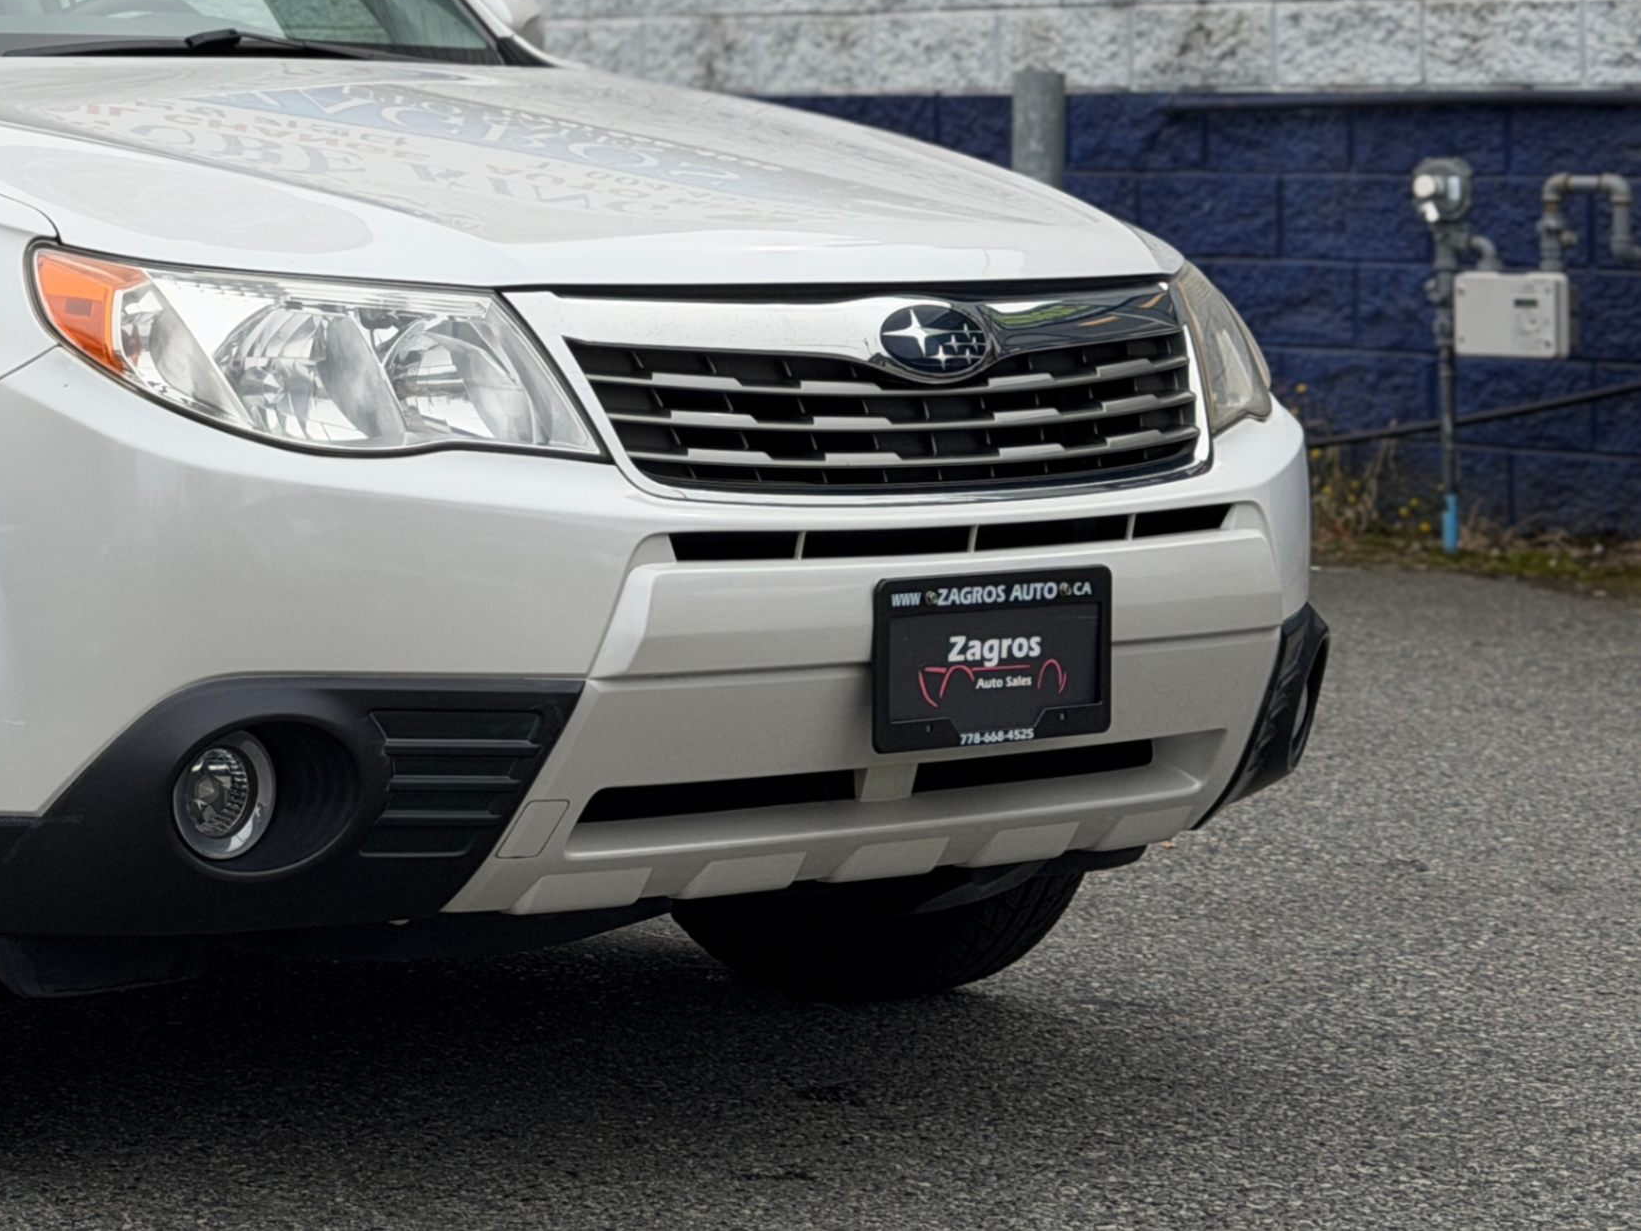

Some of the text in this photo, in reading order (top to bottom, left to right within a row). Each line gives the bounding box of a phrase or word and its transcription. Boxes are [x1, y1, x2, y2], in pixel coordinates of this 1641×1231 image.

[937, 585, 1006, 606] ZAGROS
[1009, 582, 1058, 602] AUTO
[948, 636, 1041, 668] Zagros
[976, 674, 1032, 689] Auto Sales
[960, 728, 1034, 745] 778-668-4525
